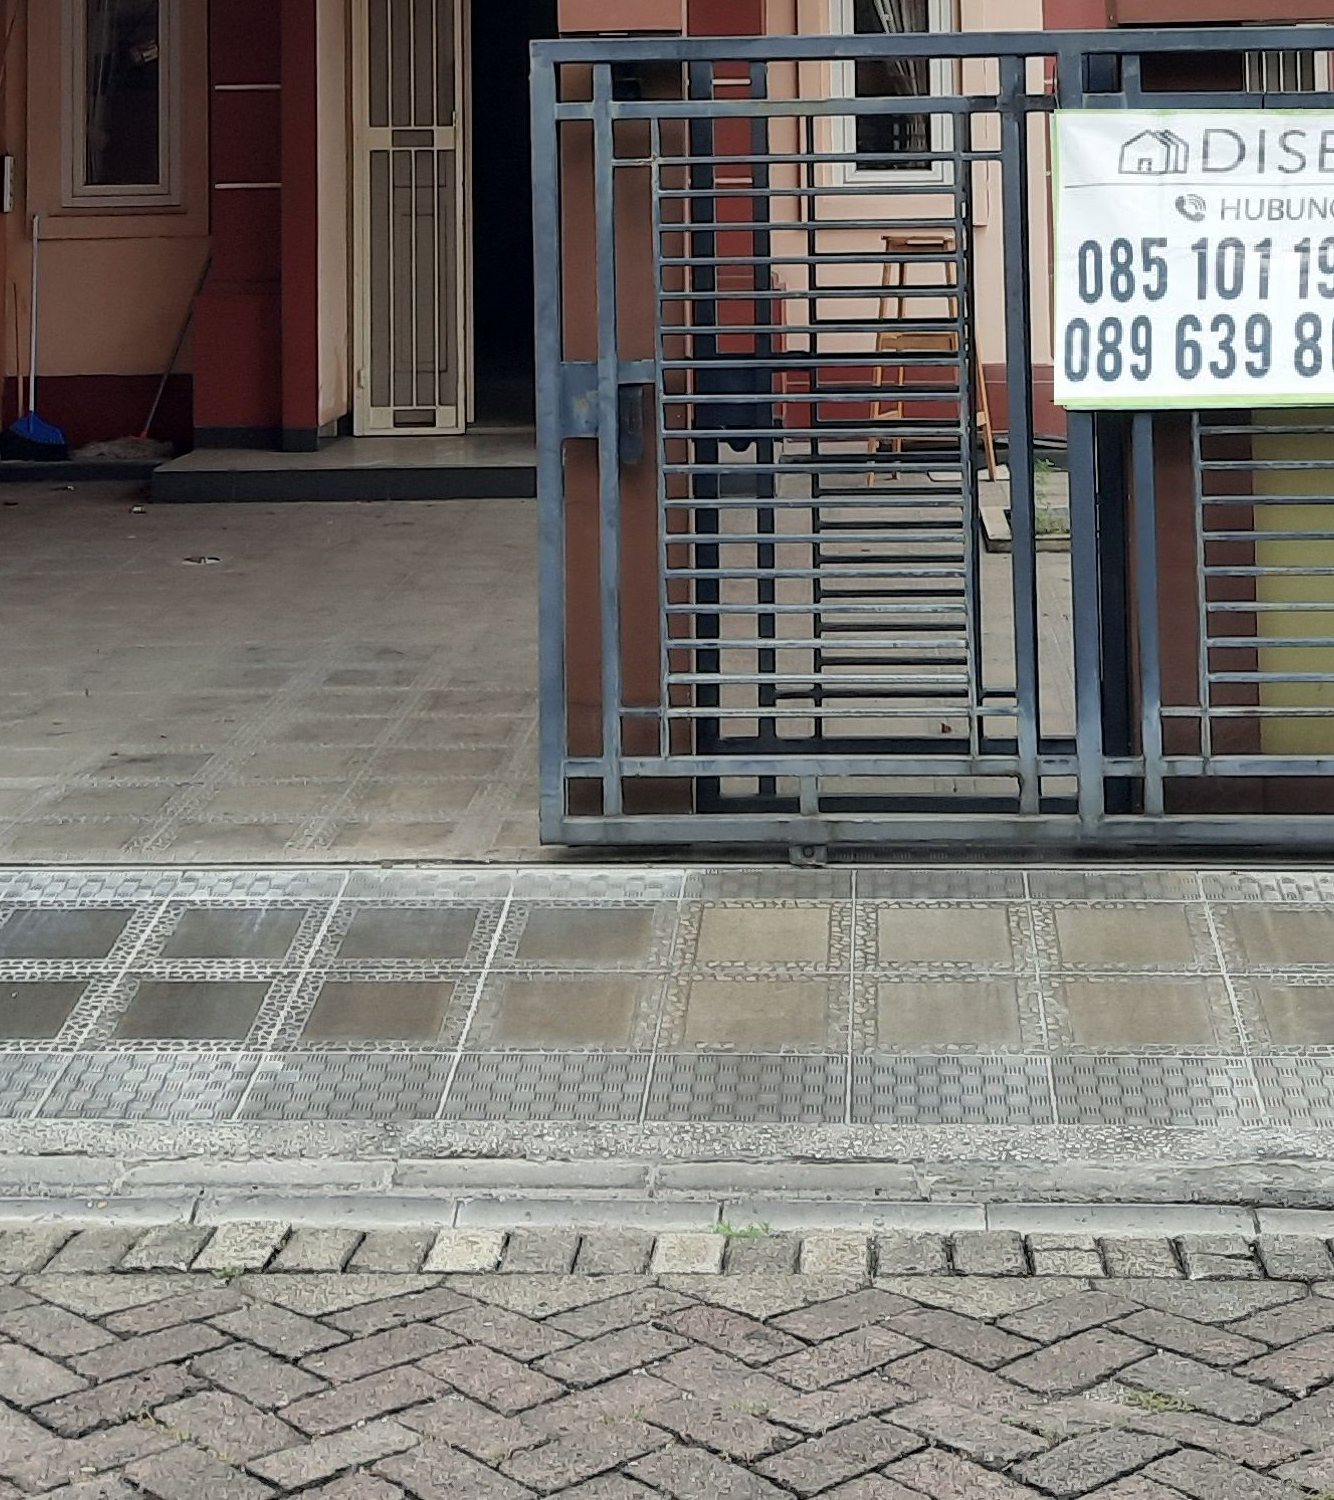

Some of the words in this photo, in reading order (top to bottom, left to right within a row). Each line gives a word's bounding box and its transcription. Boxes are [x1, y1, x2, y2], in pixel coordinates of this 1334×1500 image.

[1078, 237, 1167, 305] 085
[1191, 237, 1272, 300] 101
[1065, 315, 1152, 382] 089
[1175, 312, 1272, 379] 639
